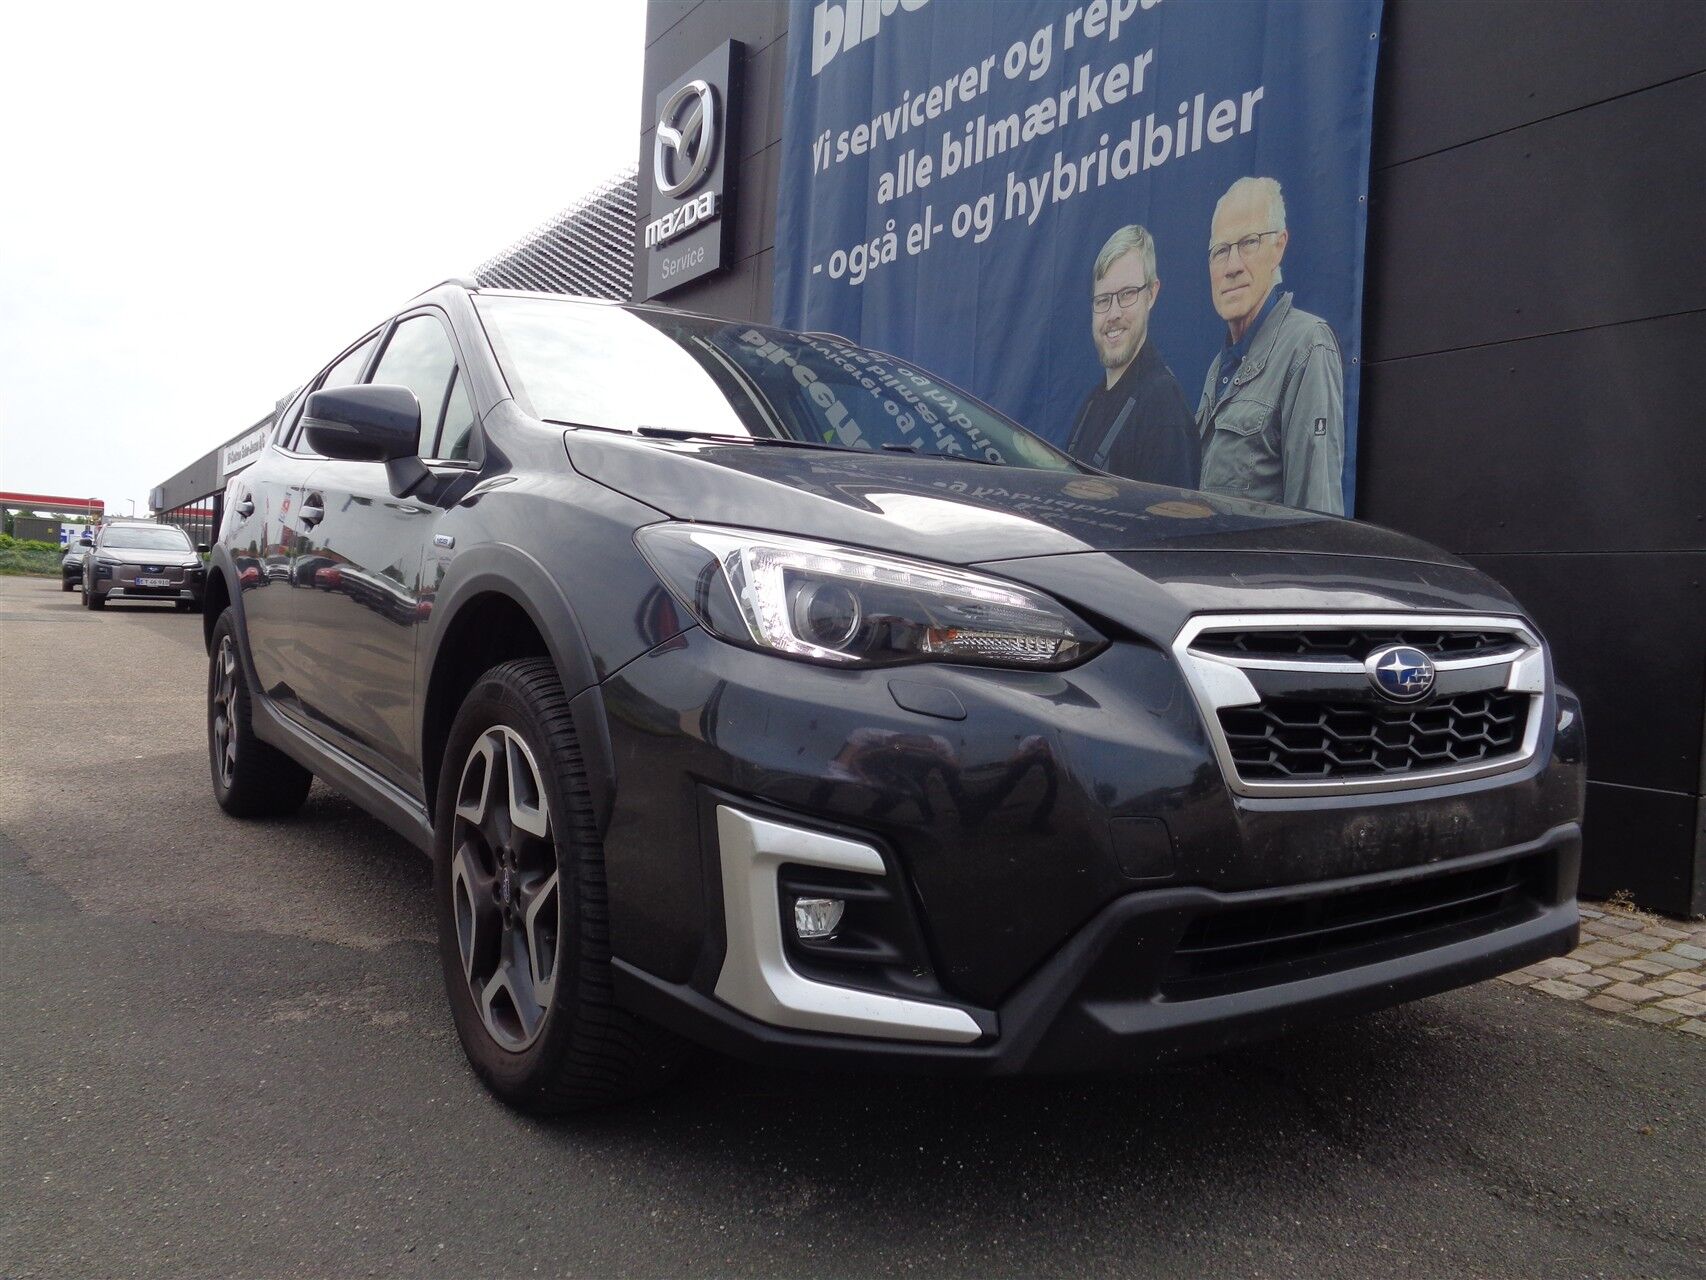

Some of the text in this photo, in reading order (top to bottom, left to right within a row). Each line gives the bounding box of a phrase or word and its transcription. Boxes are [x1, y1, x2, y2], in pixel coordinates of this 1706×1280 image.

[812, 0, 1160, 176] Vi servicerer og rep
[877, 48, 1153, 205] alle bilmærker
[661, 246, 705, 279] Service
[828, 218, 898, 285] også
[906, 205, 943, 255] el-
[951, 193, 995, 243] og
[1004, 86, 1264, 226] hybridbiler
